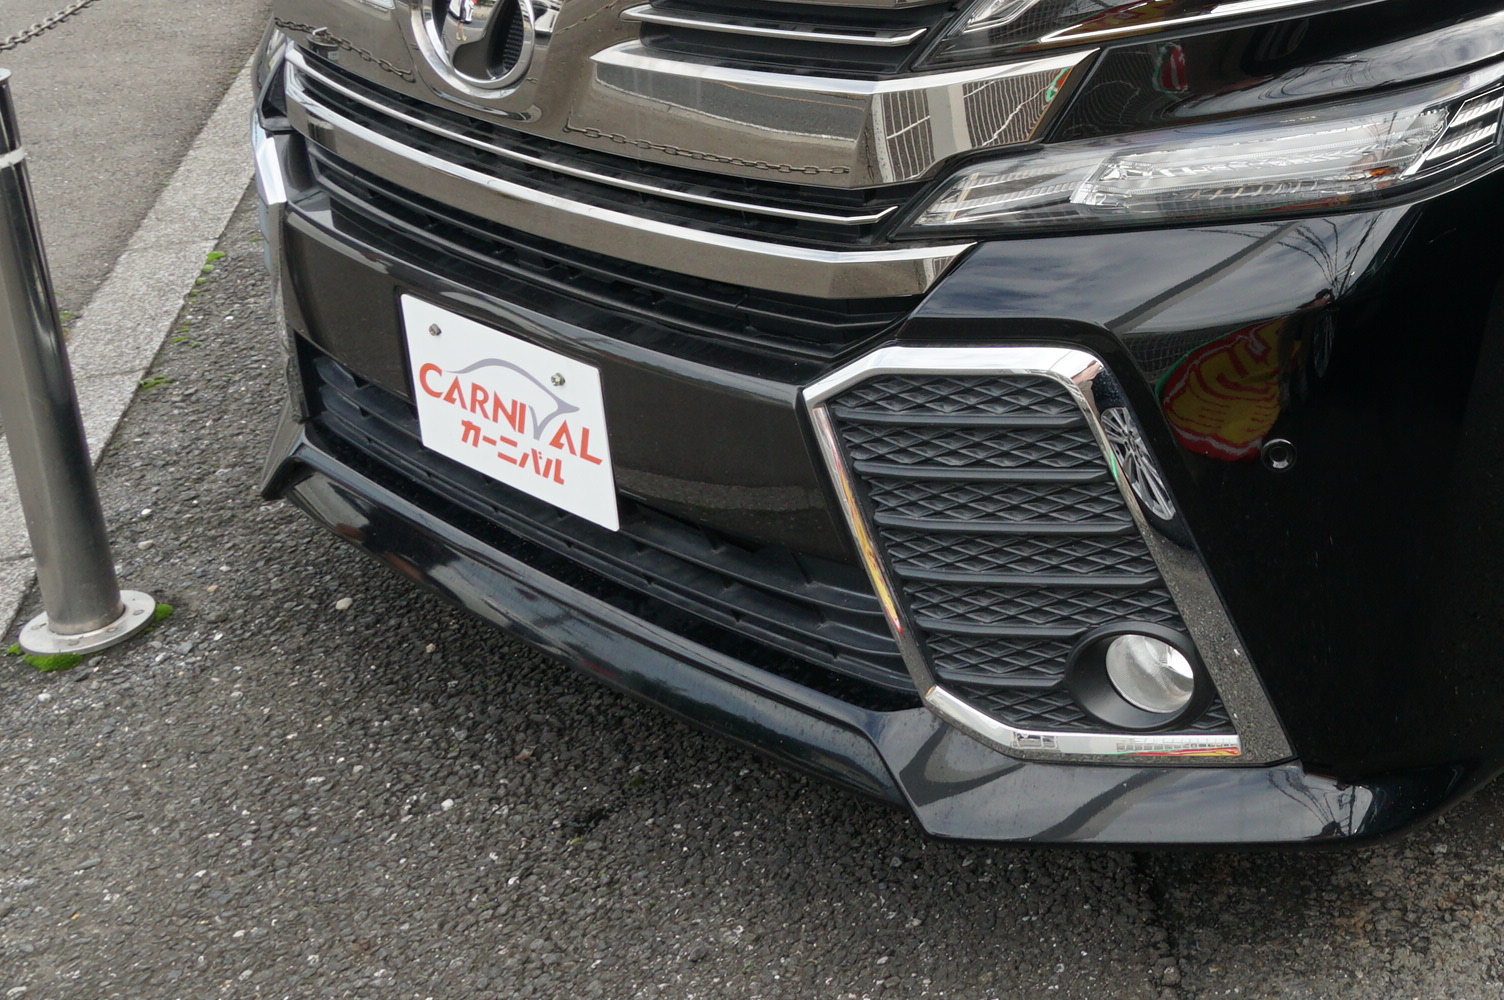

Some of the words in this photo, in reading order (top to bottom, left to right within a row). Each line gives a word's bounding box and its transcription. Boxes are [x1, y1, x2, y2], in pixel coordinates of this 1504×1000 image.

[419, 362, 603, 465] CARNIVAL
[461, 420, 565, 485] カーニバル
